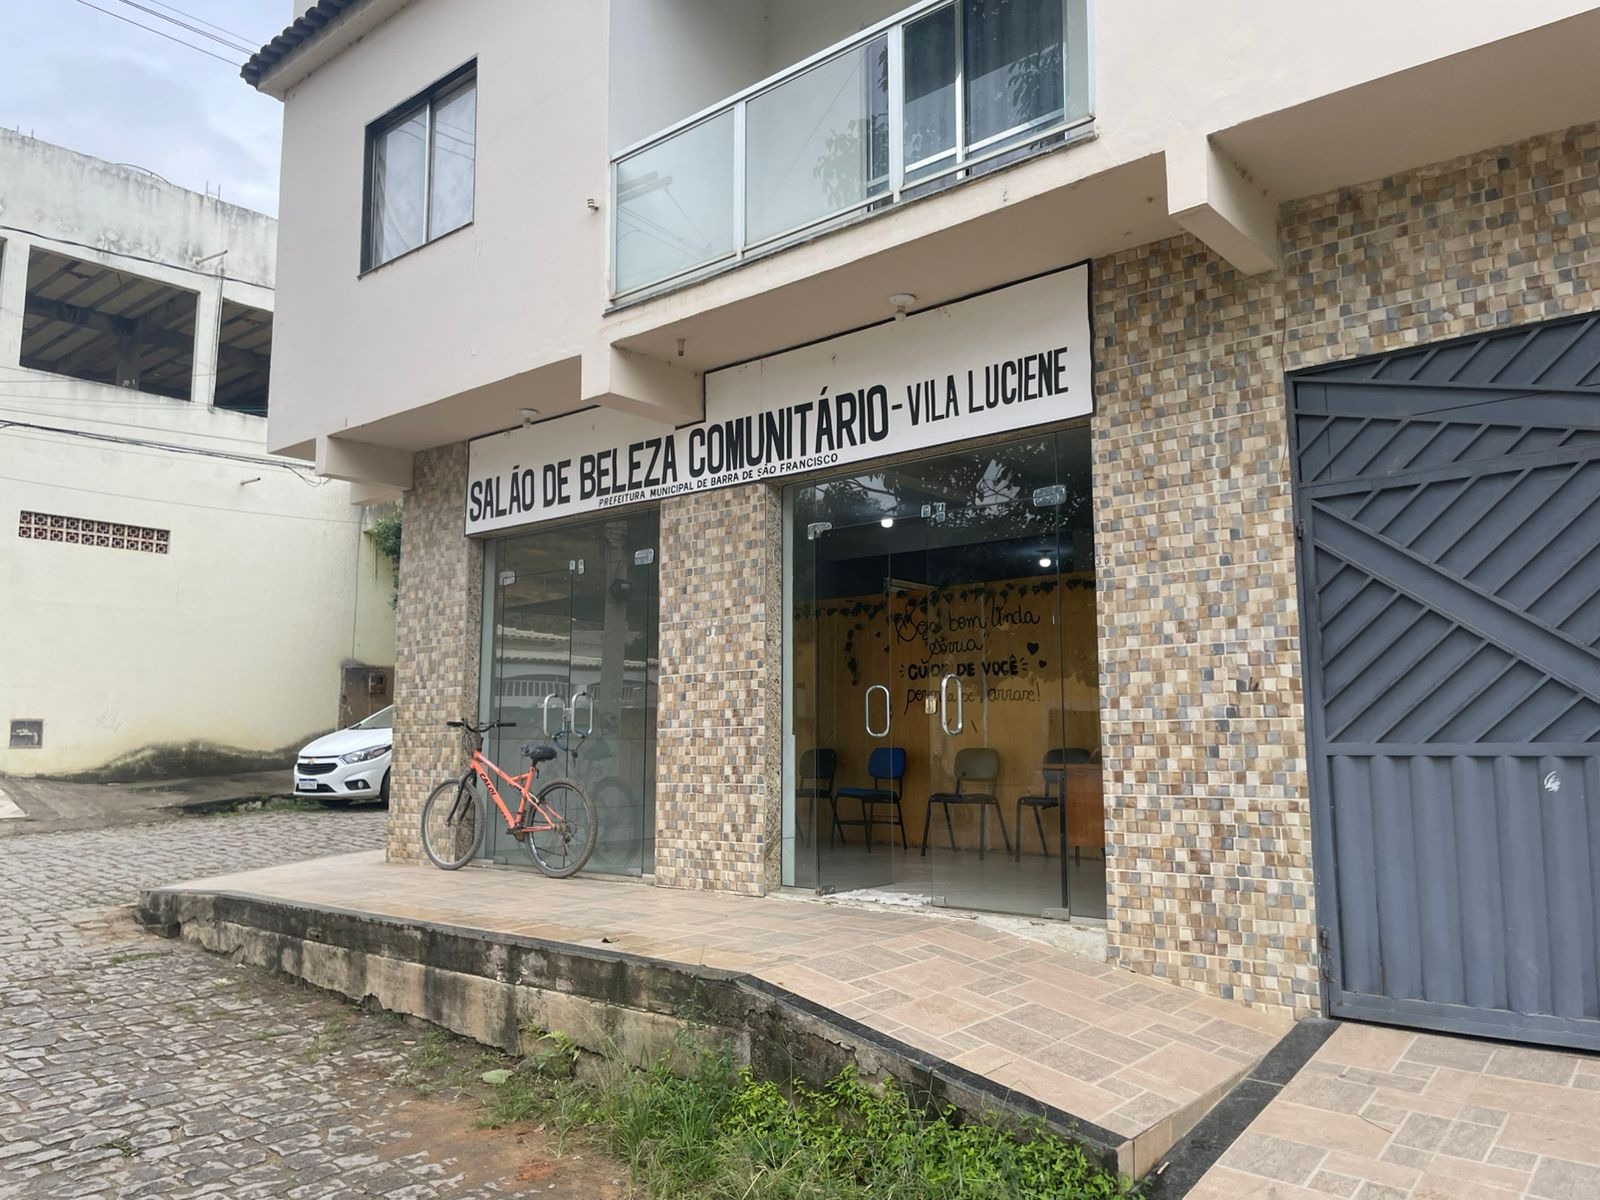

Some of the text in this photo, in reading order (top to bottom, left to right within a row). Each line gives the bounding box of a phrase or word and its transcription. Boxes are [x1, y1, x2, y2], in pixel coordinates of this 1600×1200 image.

[469, 464, 534, 522] SALÃO
[543, 459, 571, 508] DE
[580, 434, 677, 500] BELEZA
[689, 384, 888, 478] COMUNITÁRIO
[907, 374, 959, 426] VILA
[968, 346, 1069, 414] LUCIENE
[598, 491, 646, 507] PREFEITURA
[650, 482, 694, 498] MUNICIPAL
[697, 478, 708, 489] DE
[711, 472, 739, 485] BARRA
[743, 470, 753, 480] DE
[780, 453, 838, 473] FRANCISCO
[957, 663, 975, 677] DE
